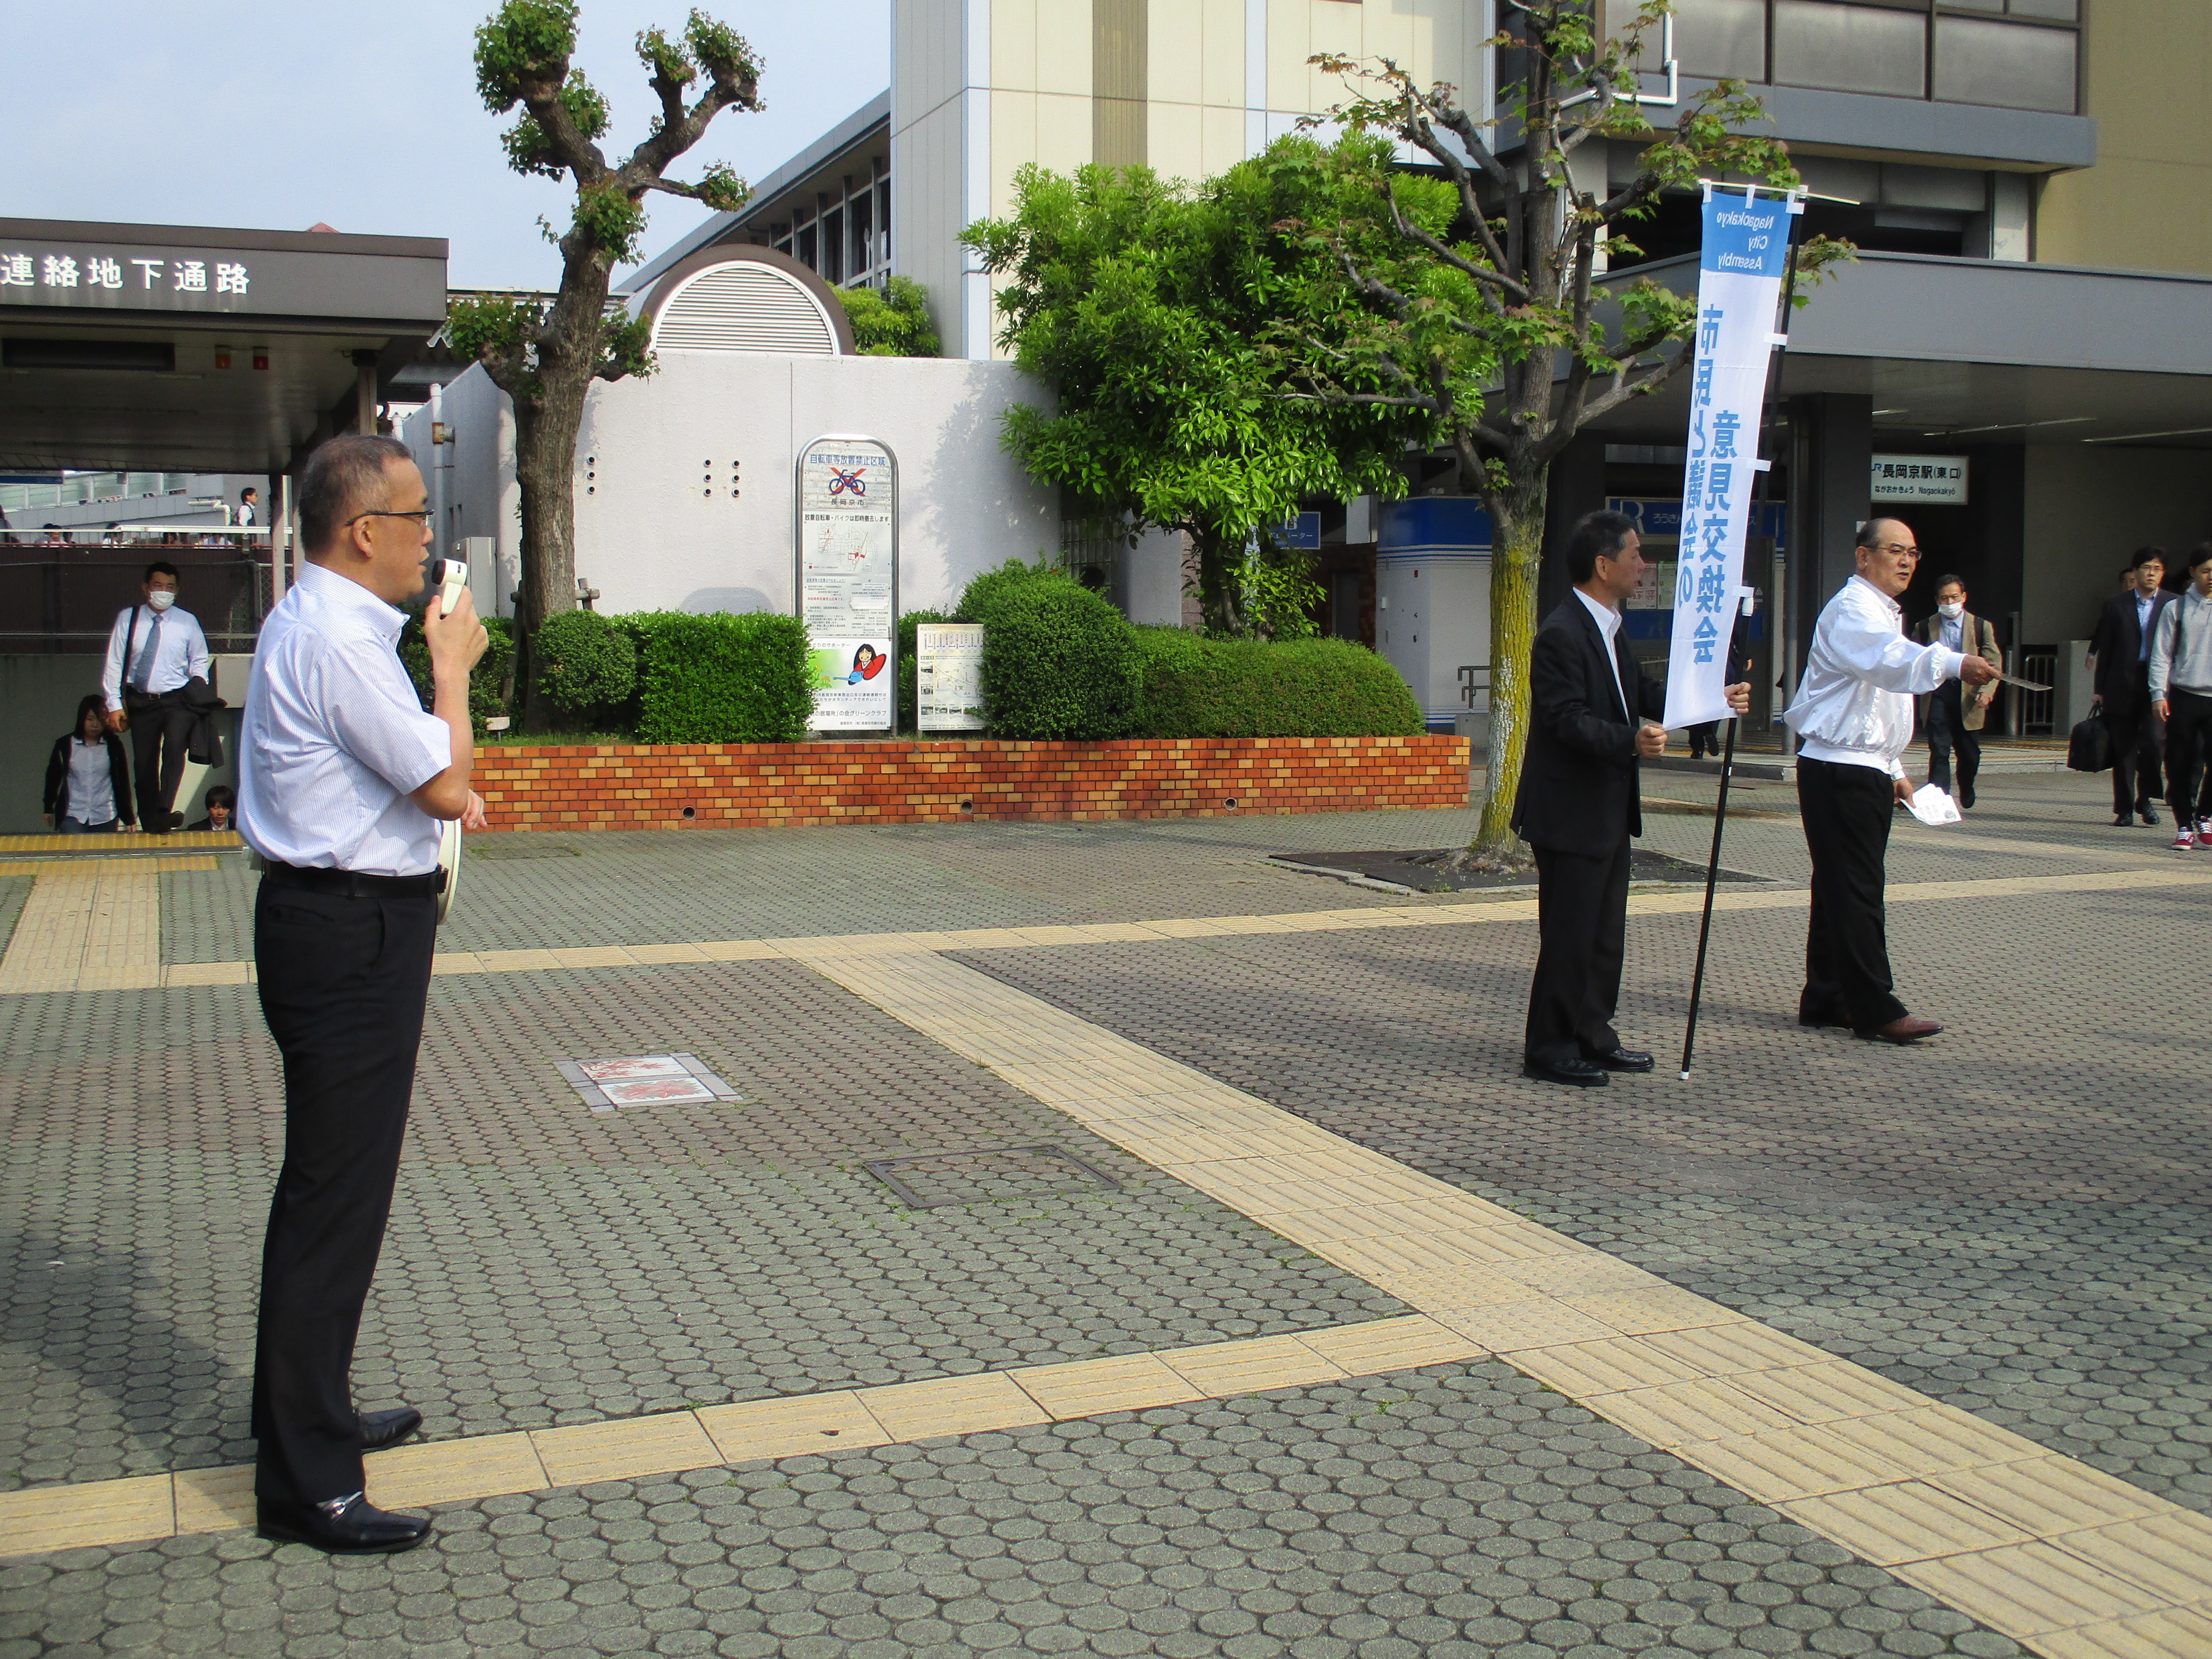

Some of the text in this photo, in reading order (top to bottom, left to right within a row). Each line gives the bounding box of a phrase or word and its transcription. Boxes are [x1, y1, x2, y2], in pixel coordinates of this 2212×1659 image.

[0, 254, 250, 295] 連絡地下通路
[810, 455, 885, 466] 自転車等放置禁止区域
[1875, 485, 1914, 494] ながおかきょう
